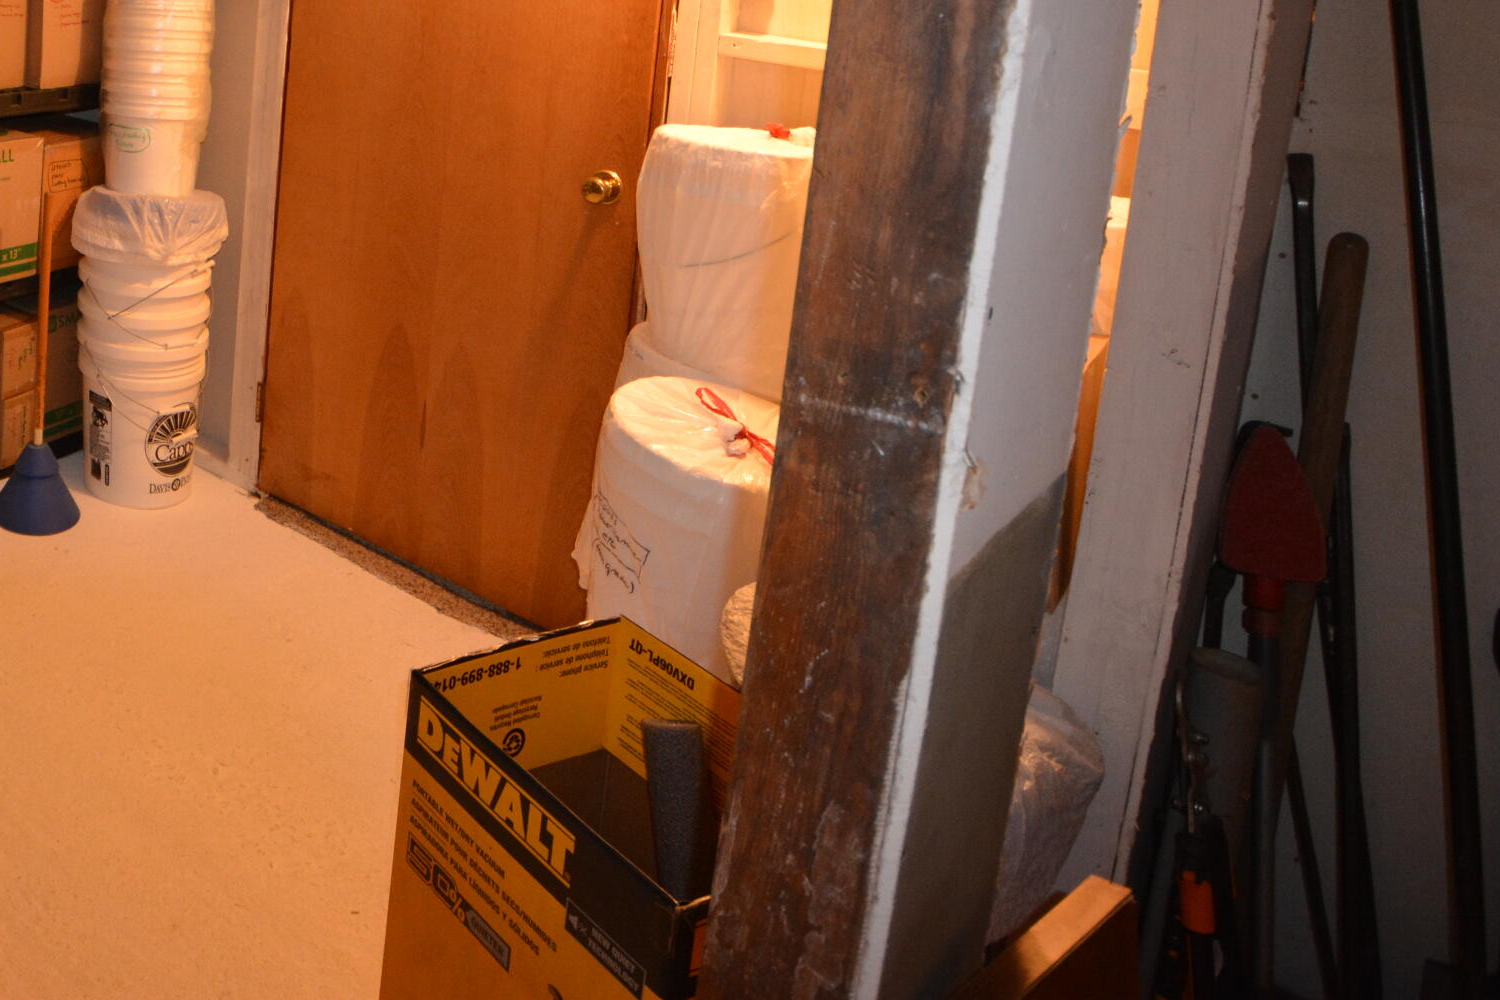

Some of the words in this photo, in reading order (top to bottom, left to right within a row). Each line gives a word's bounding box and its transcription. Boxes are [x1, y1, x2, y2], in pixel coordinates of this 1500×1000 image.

[629, 638, 695, 691] DXV06PL-QT
[412, 779, 444, 819] PORTABLE
[476, 841, 506, 880] VACUUM
